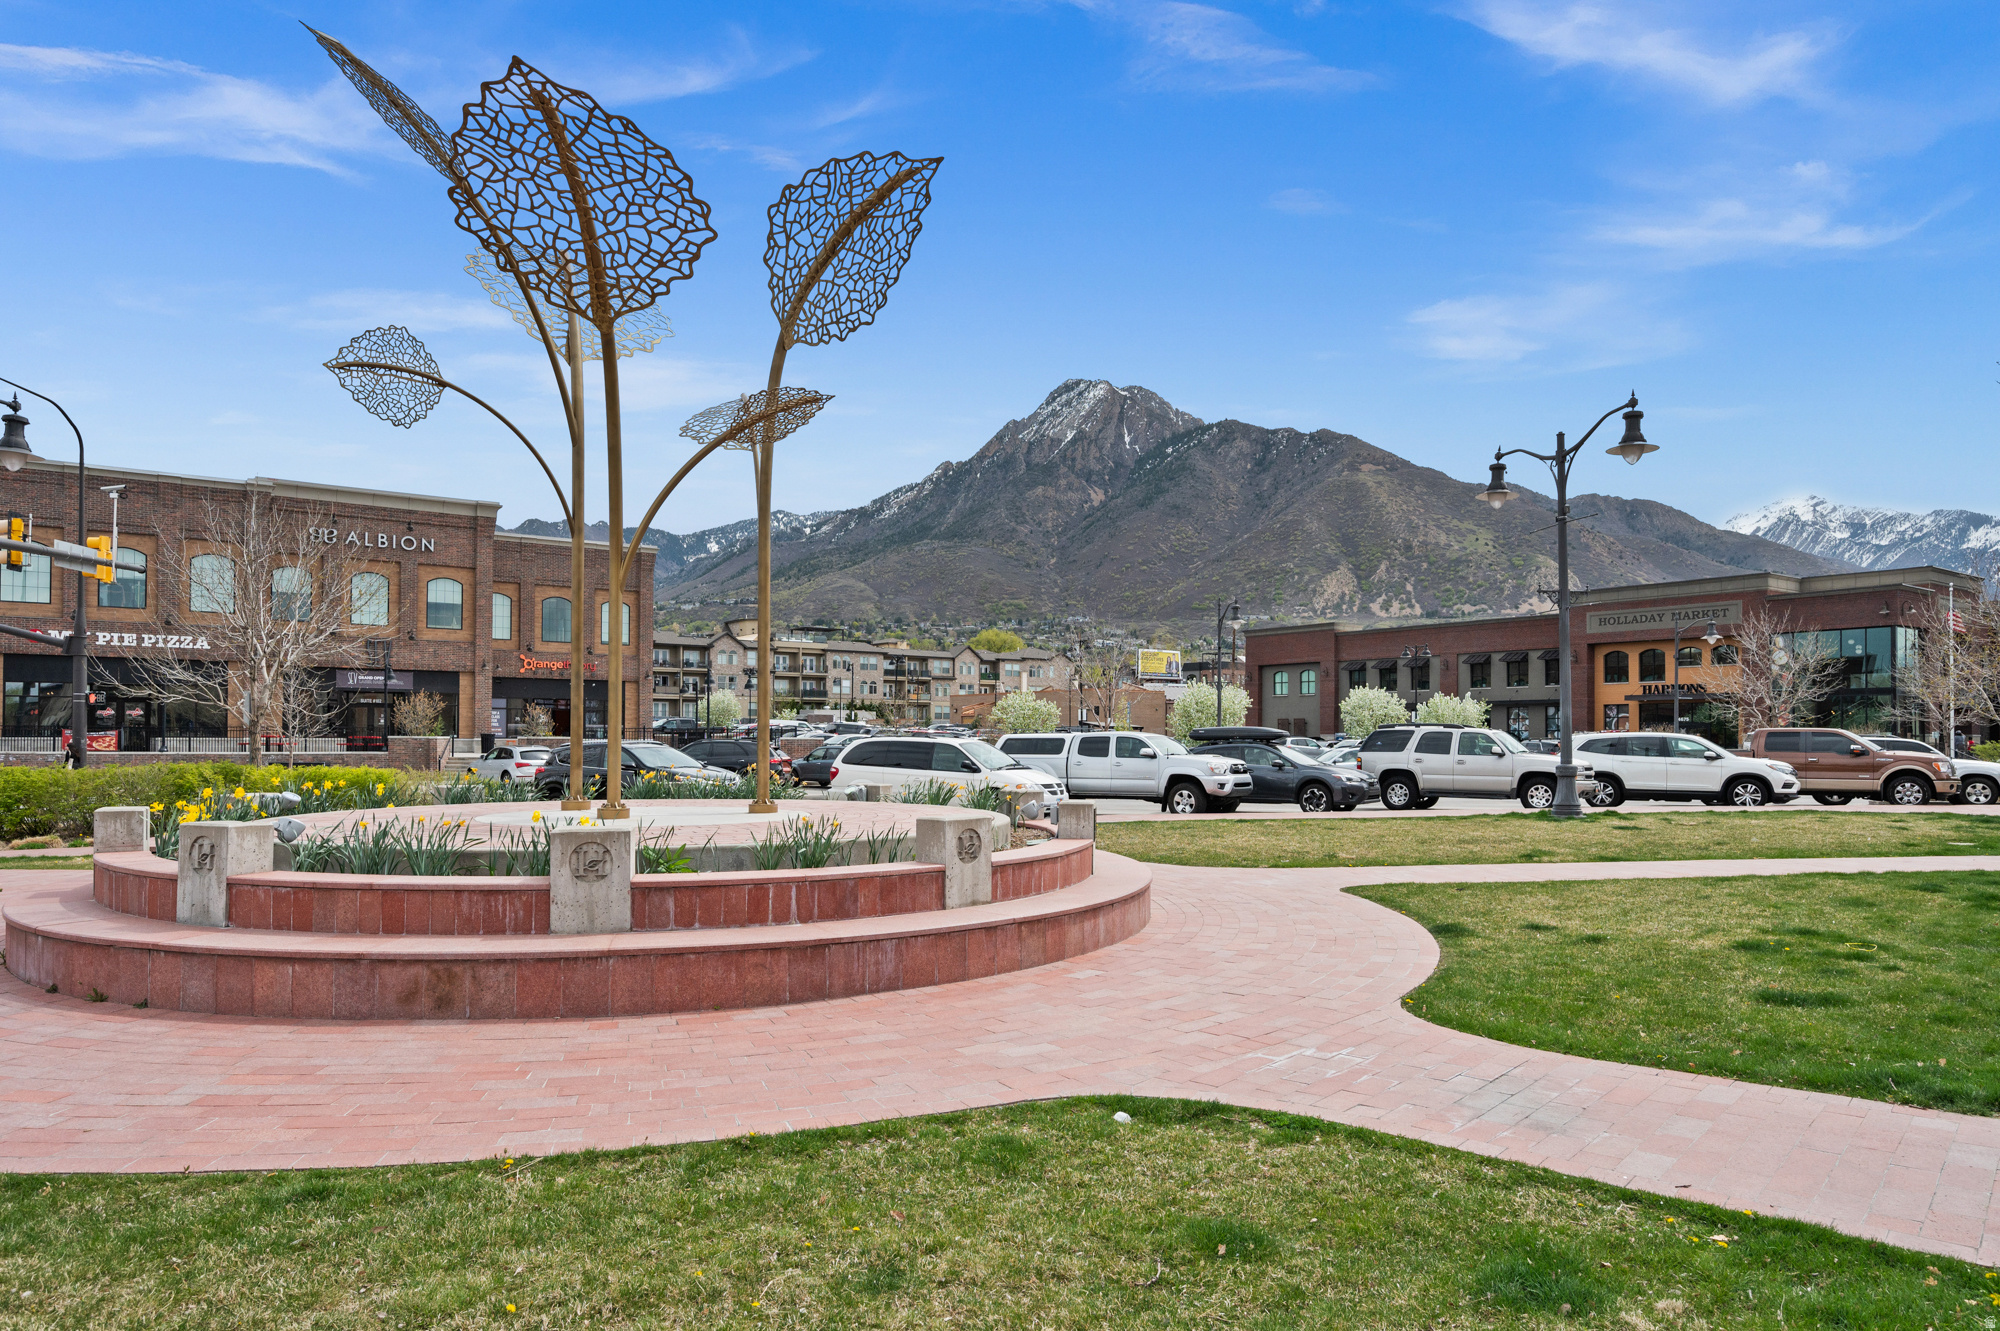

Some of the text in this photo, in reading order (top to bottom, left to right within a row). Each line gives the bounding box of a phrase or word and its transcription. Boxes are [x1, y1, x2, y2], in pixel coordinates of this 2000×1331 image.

[345, 531, 434, 552] ALBION
[1598, 607, 1729, 627] HOLLADAY MARKET
[95, 632, 137, 647] PIE
[141, 634, 211, 650] PIZZA
